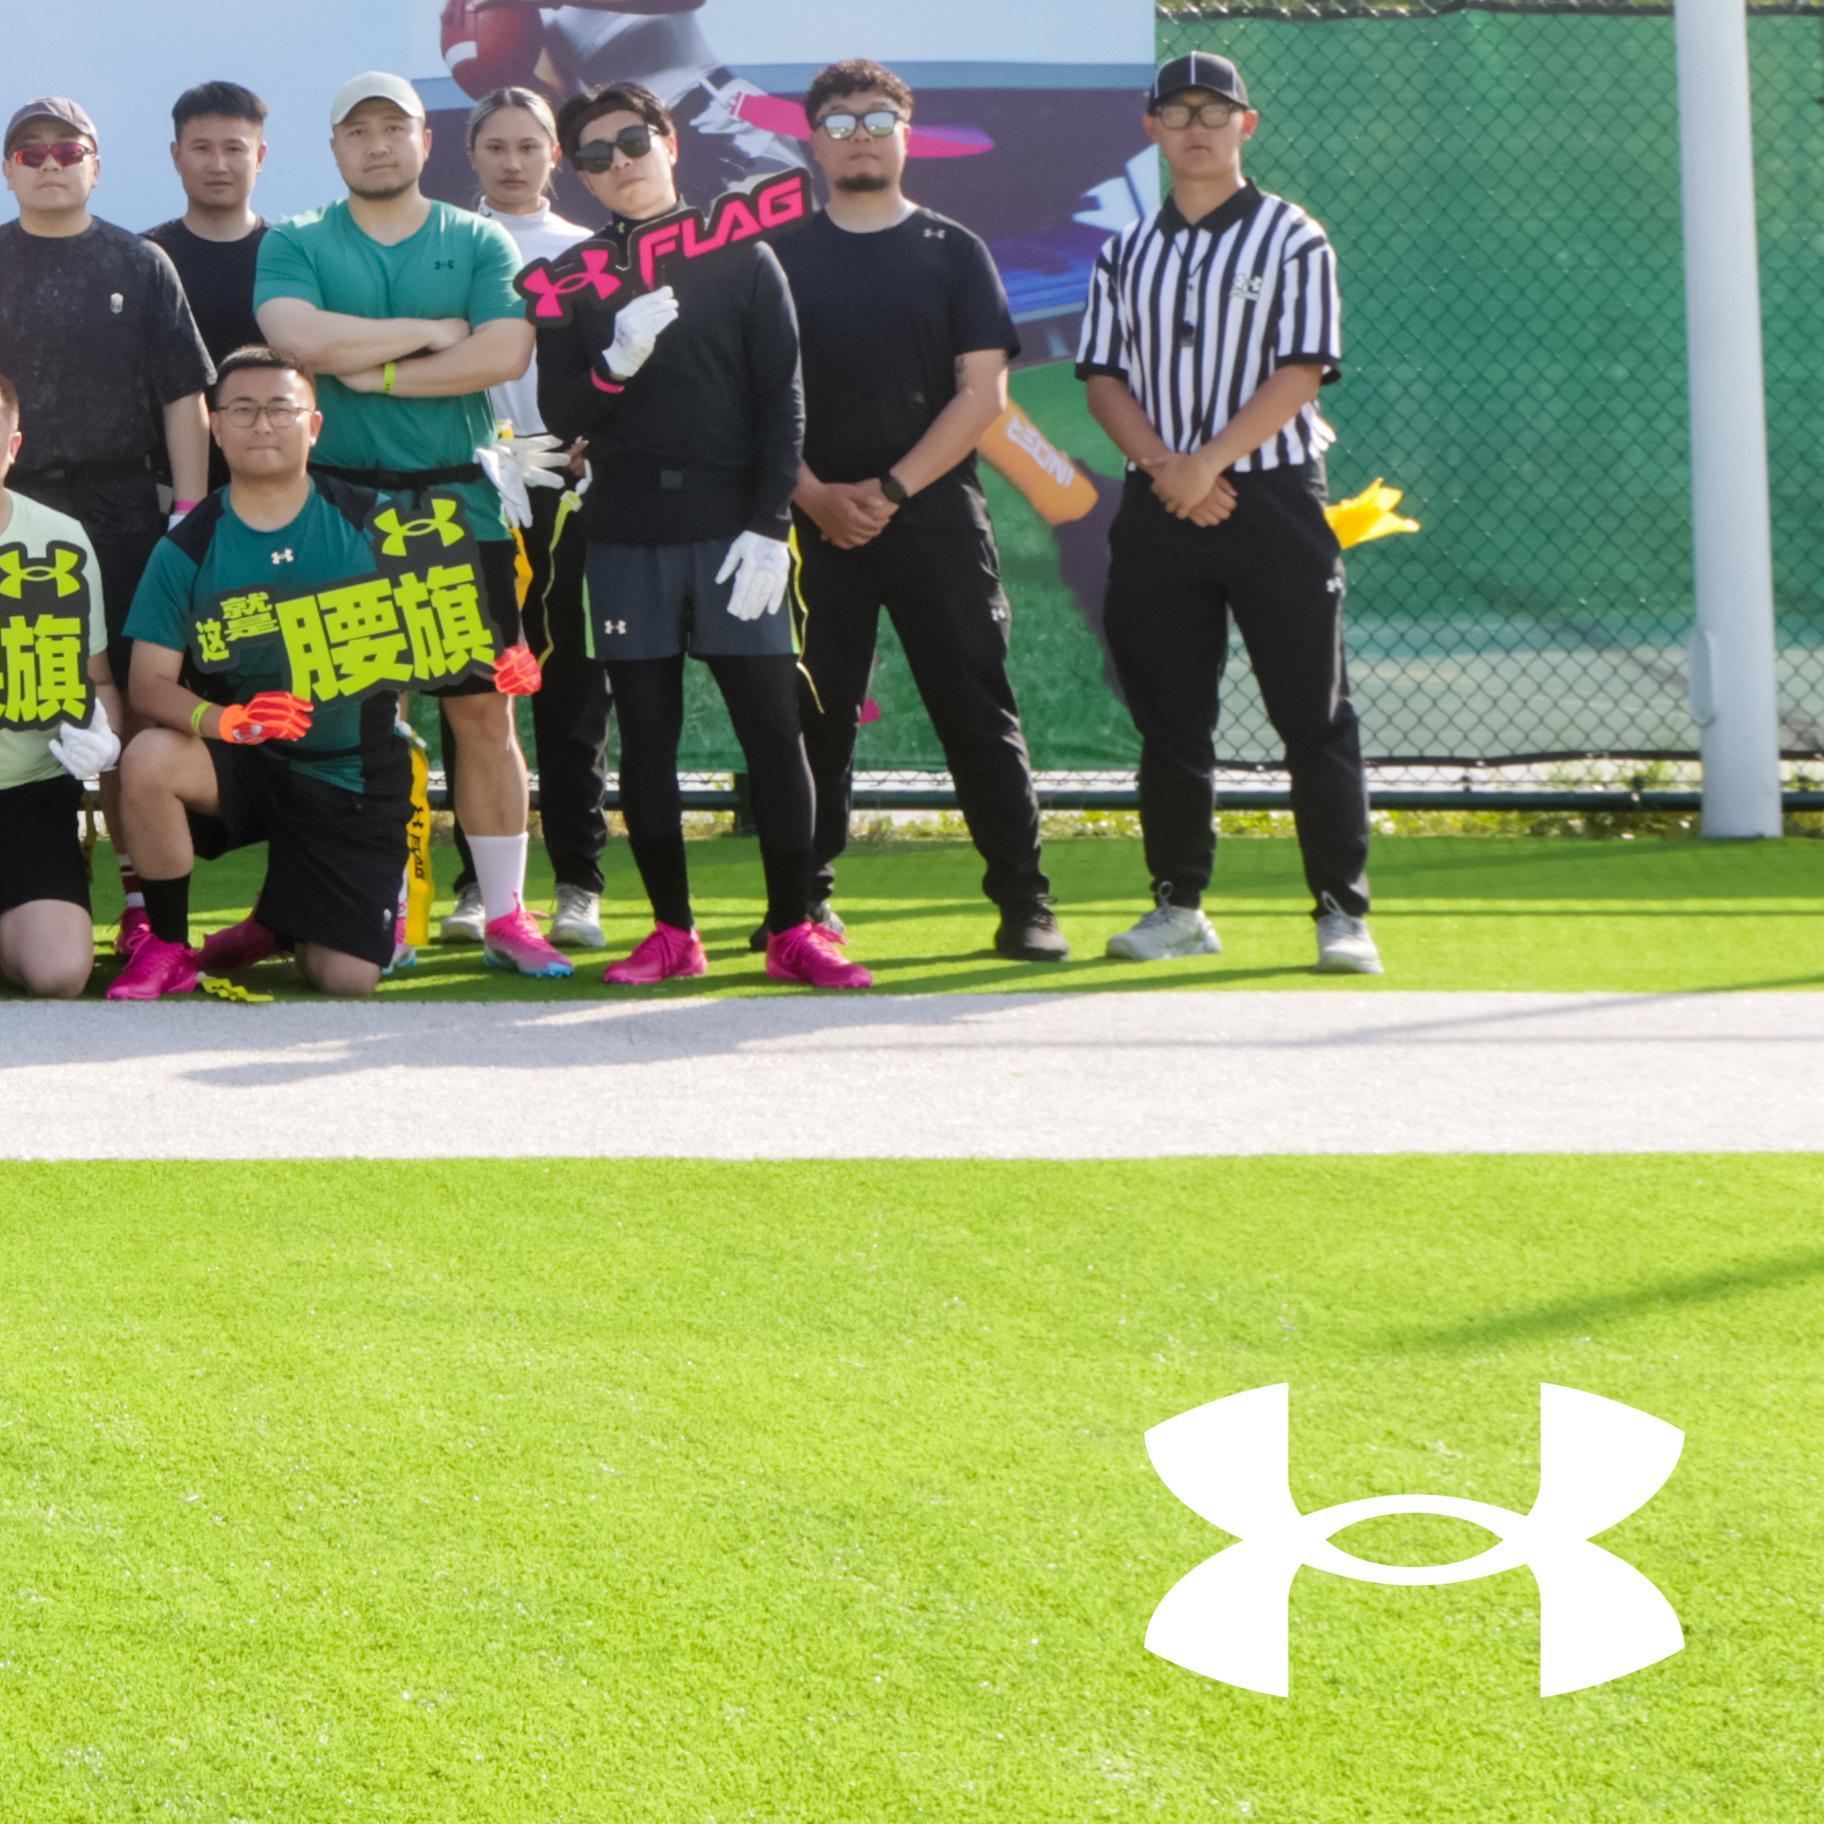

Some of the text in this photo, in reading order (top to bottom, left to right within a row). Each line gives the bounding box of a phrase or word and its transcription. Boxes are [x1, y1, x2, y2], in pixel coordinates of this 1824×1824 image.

[637, 176, 806, 288] FLAG
[194, 565, 497, 703] 这就是腰旗
